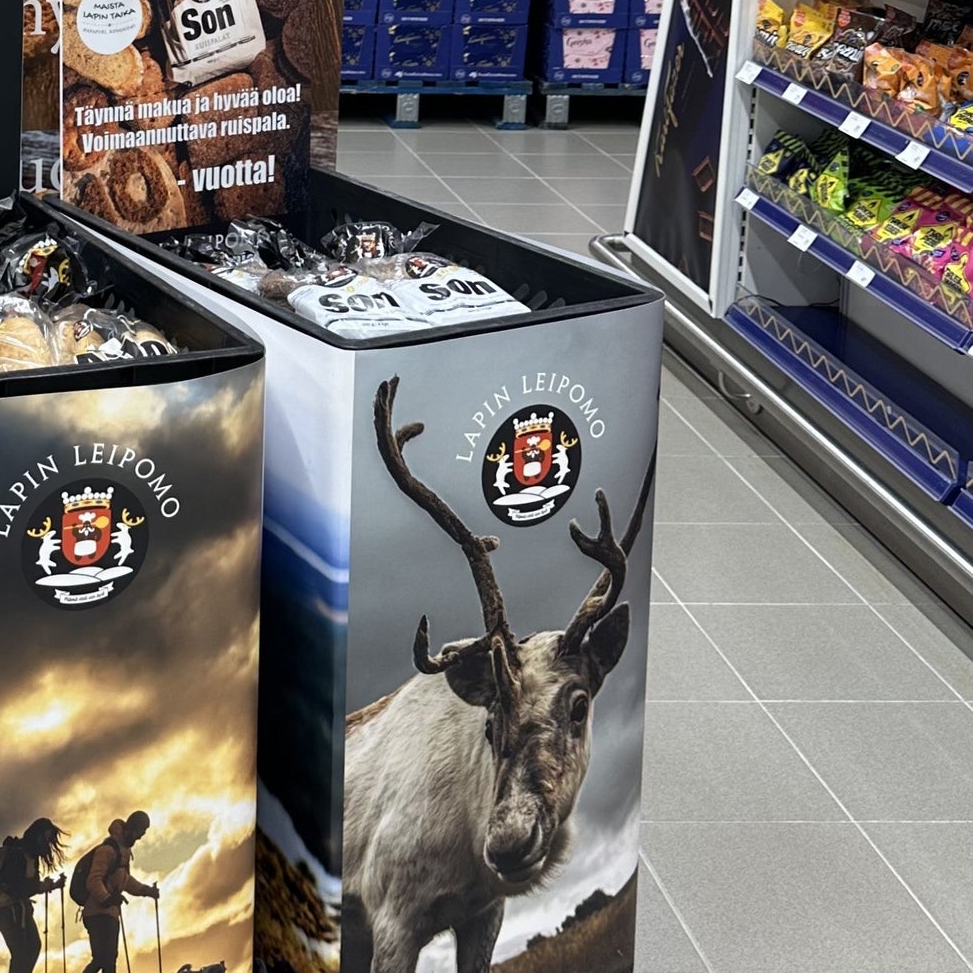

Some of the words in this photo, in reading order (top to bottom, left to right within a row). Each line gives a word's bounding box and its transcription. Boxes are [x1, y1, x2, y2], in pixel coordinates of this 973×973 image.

[82, 10, 110, 20] LAPIN
[110, 8, 136, 20] TAIKA
[93, 1, 125, 11] MAISTA
[181, 3, 236, 42] Son
[74, 102, 135, 127] Täynnä
[137, 97, 192, 119] makua
[194, 93, 210, 115] ja
[213, 87, 260, 112] hyvää
[262, 83, 302, 104] oloa!
[82, 122, 218, 154] Voimaannuttava
[221, 112, 291, 137] ruispala.
[192, 154, 276, 193] vuotta!
[317, 290, 401, 314] Son
[416, 277, 498, 302] Son
[456, 384, 513, 464] LAPIN
[521, 371, 606, 440] LEIPOMO
[73, 441, 181, 520] LEIPOMO
